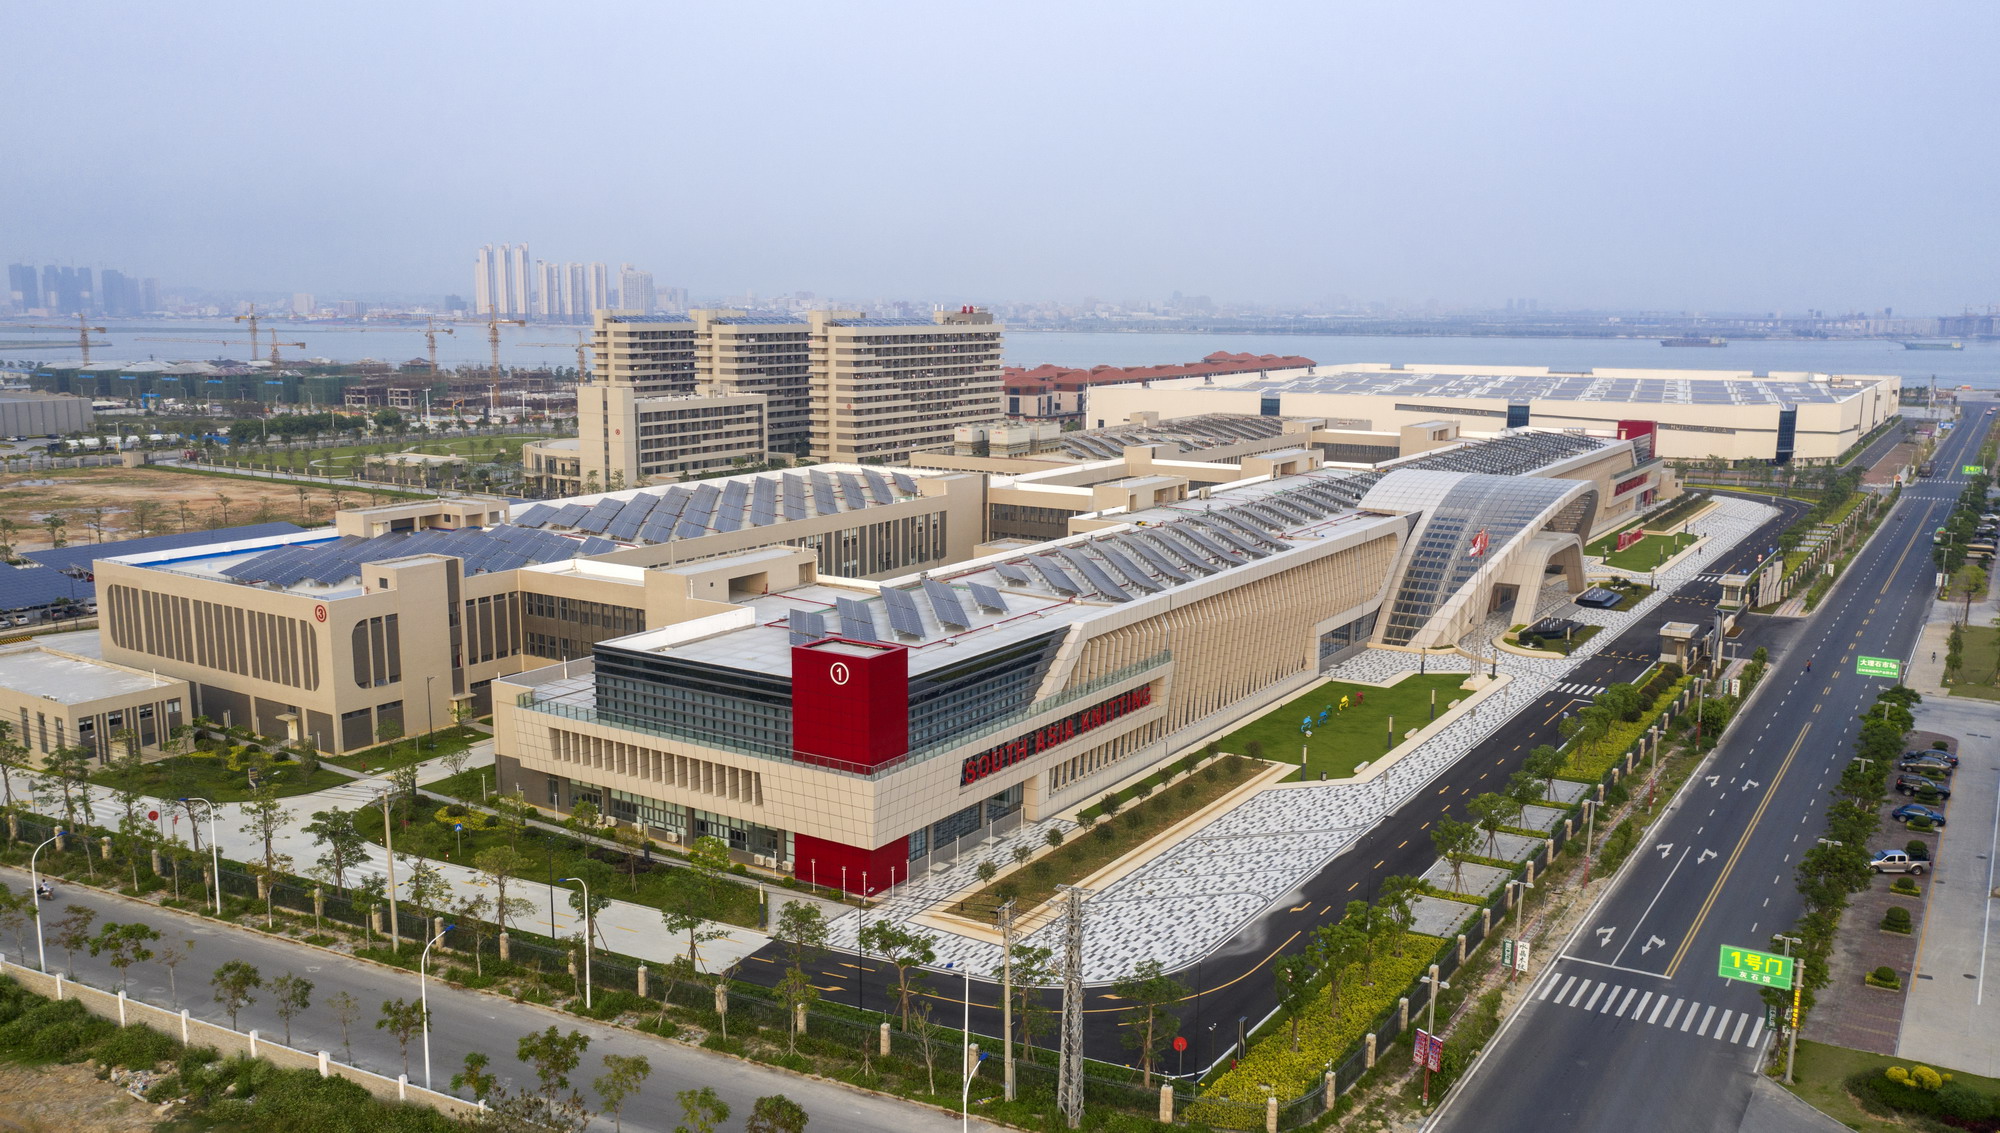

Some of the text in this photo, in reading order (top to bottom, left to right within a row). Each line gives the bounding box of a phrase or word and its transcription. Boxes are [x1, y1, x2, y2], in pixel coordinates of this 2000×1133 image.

[1458, 408, 1489, 416] CHINA
[1860, 659, 1897, 670] 大理石市场
[965, 686, 1152, 784] SOUTH ASIA KNITTING
[1730, 951, 1783, 976] 1号门
